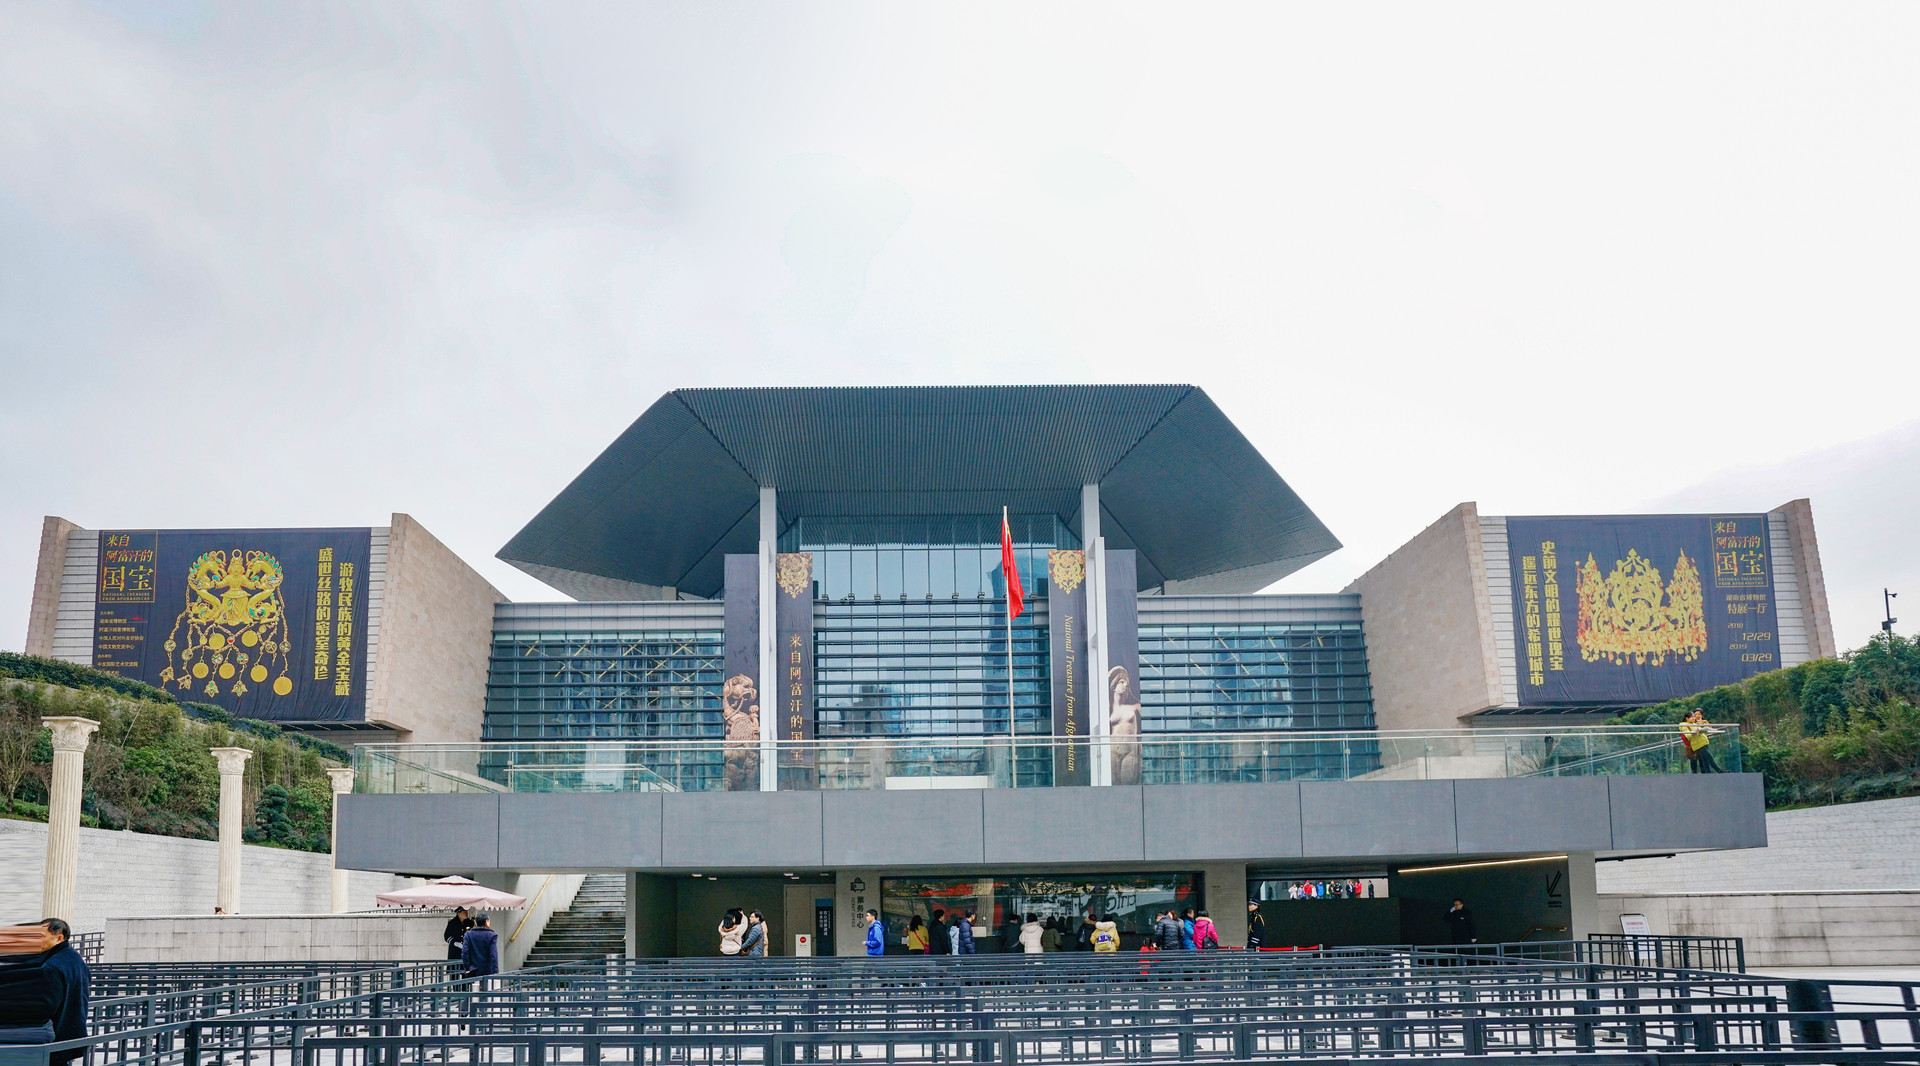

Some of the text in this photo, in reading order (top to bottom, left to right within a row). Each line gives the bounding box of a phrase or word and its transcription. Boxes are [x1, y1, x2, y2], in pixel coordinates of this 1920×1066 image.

[1715, 521, 1736, 534] 来自
[106, 534, 130, 547] 来自
[1716, 535, 1761, 549] 阿富汗的
[105, 549, 153, 563] 阿富汗的
[1716, 550, 1765, 577] 国宝
[103, 565, 154, 592] 国宝
[314, 548, 333, 680] 盛世丝路的密室奇珍
[1542, 541, 1564, 671] 史前文明的耀世瑰宝
[1727, 603, 1768, 614] 特展一厅
[335, 562, 354, 696] 游牧民族的黄金宝藏
[1742, 632, 1771, 641] 12/29
[1741, 653, 1772, 662] 03/29
[1065, 614, 1077, 772] National Treasure from Afganistan
[856, 896, 864, 928] 票务中心
